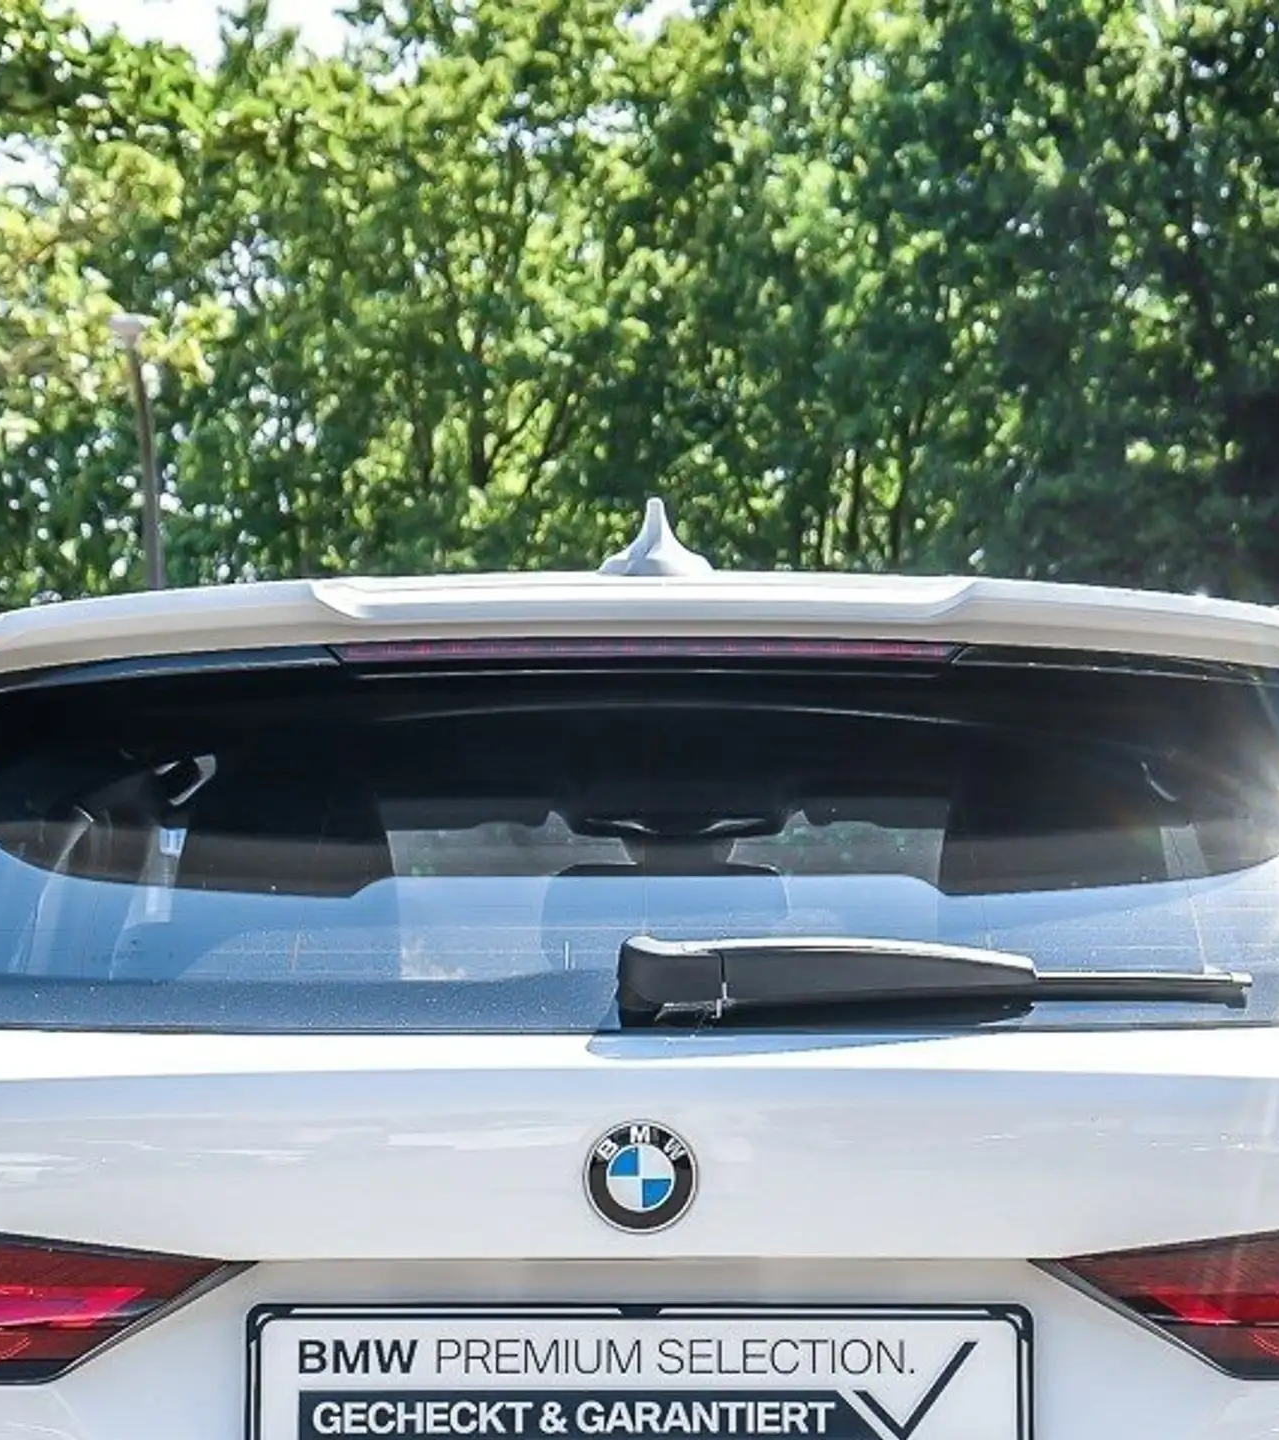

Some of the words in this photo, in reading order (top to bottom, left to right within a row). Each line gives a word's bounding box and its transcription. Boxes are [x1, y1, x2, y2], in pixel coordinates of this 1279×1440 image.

[596, 1124, 688, 1161] BMW
[298, 1338, 419, 1375] BMW
[435, 1338, 641, 1375] PREMIUM
[656, 1338, 915, 1376] SELECTION.
[312, 1401, 533, 1434] GECHECKT
[539, 1401, 568, 1434] &
[576, 1401, 836, 1434] GARANTIERT
